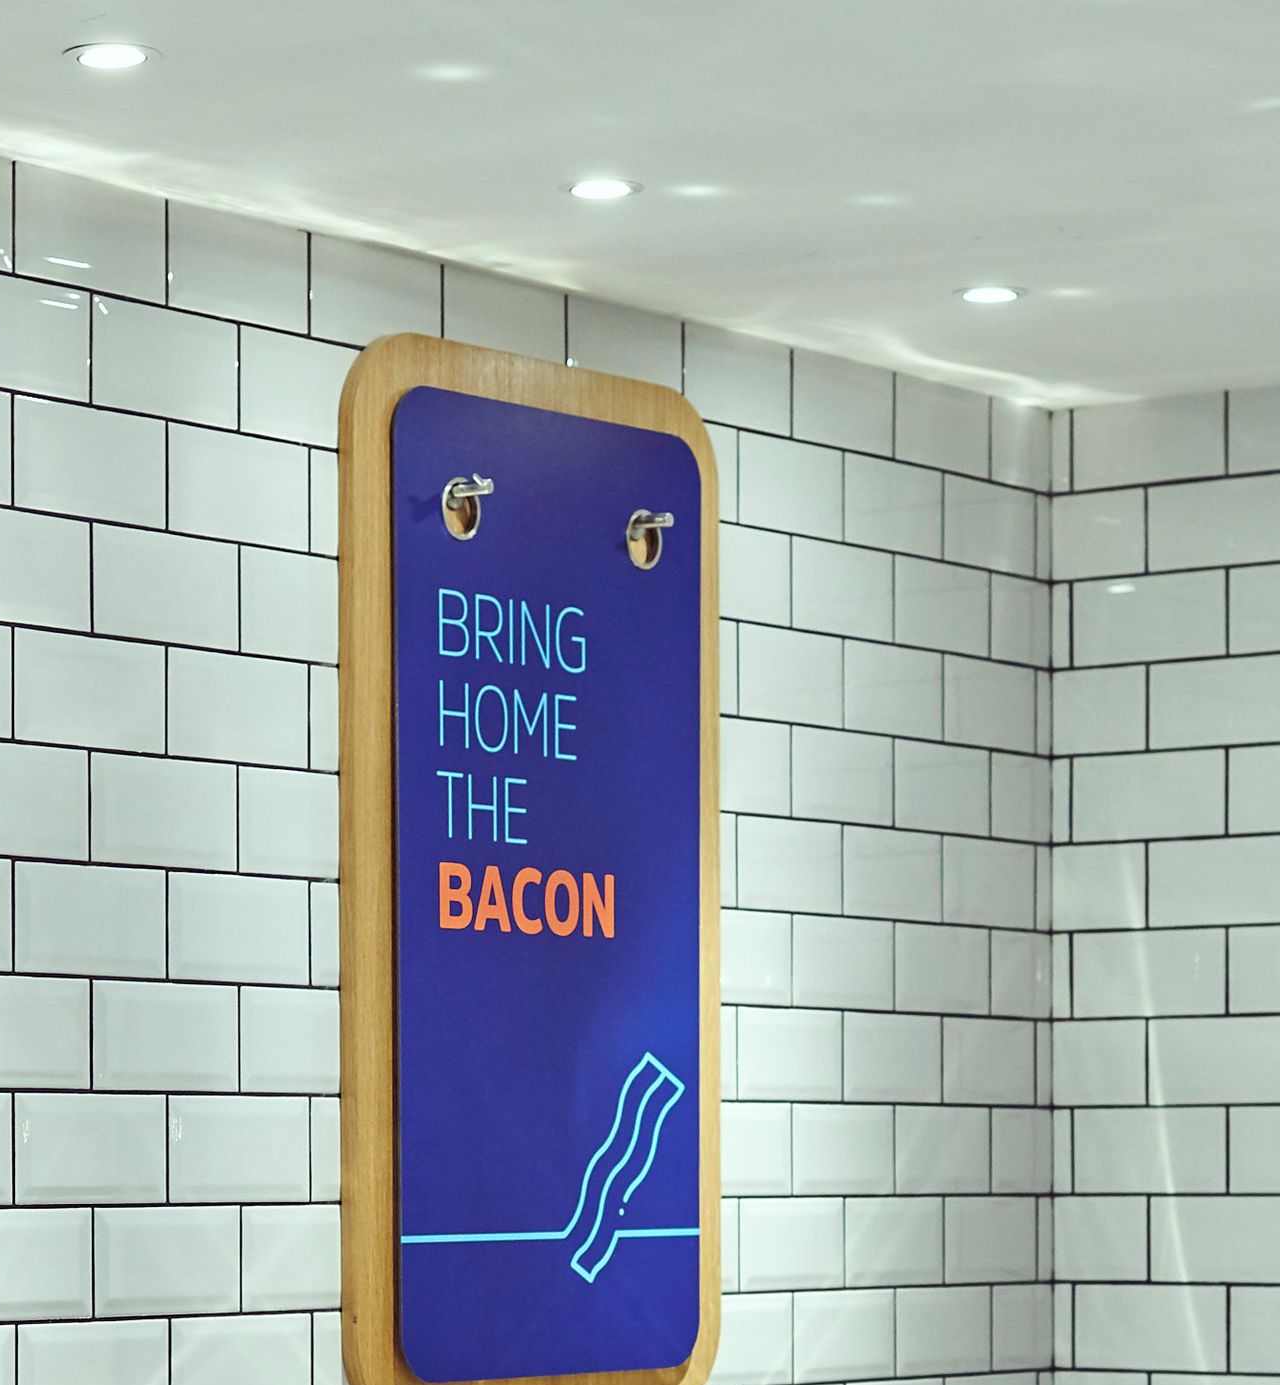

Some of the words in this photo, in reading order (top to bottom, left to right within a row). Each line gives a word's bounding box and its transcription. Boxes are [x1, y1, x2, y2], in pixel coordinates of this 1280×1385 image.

[438, 588, 586, 674] BRING
[439, 679, 577, 760] HOME
[436, 769, 528, 845] THE
[439, 861, 616, 938] BACON
